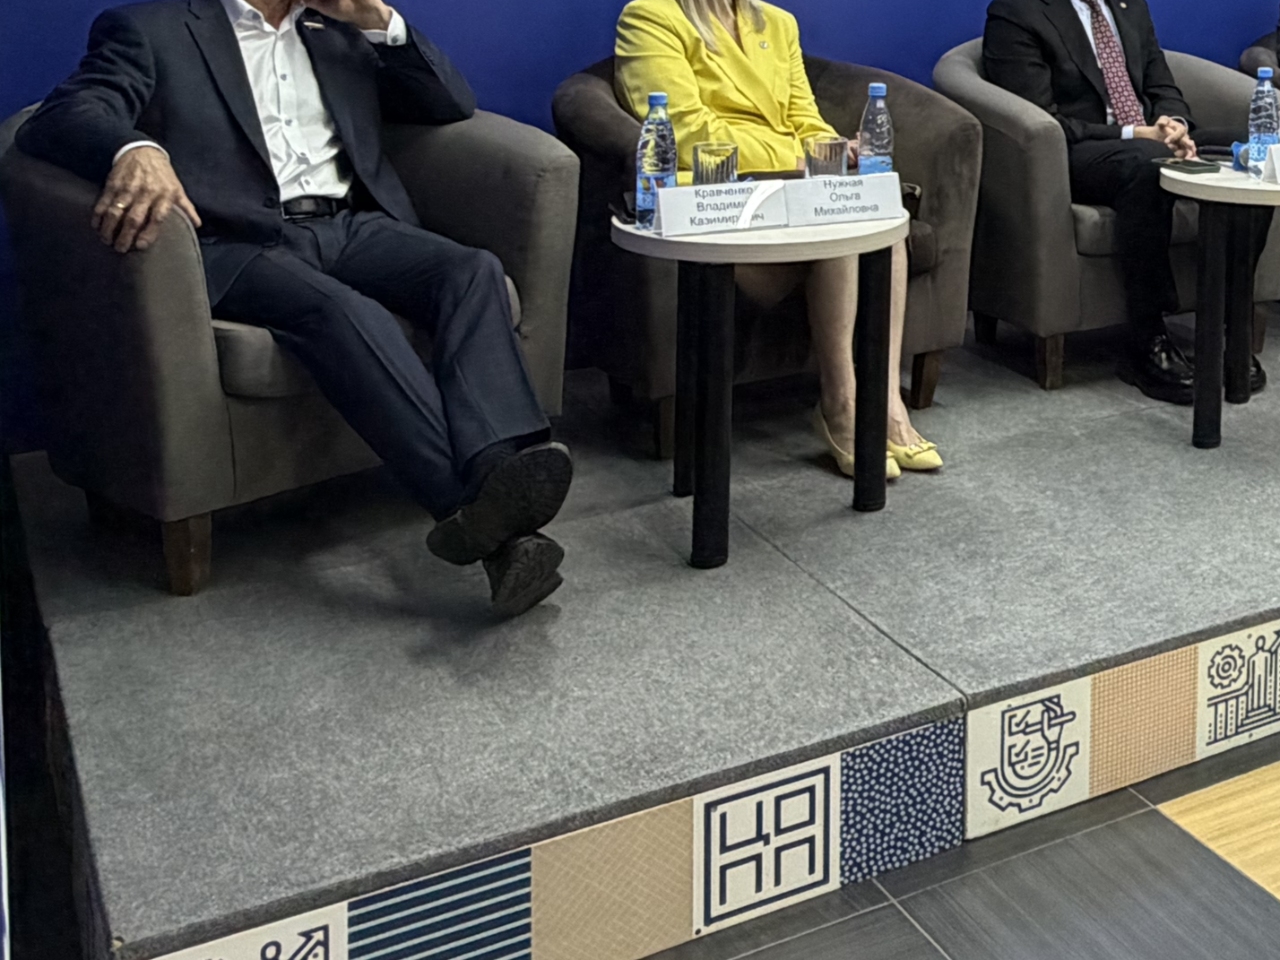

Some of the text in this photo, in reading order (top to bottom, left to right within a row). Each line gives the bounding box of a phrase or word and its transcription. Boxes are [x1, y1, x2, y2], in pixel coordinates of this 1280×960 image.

[823, 178, 864, 191] Нужная
[694, 187, 754, 200] Кравченко
[829, 191, 861, 203] Ольга
[813, 203, 880, 217] Михайловна
